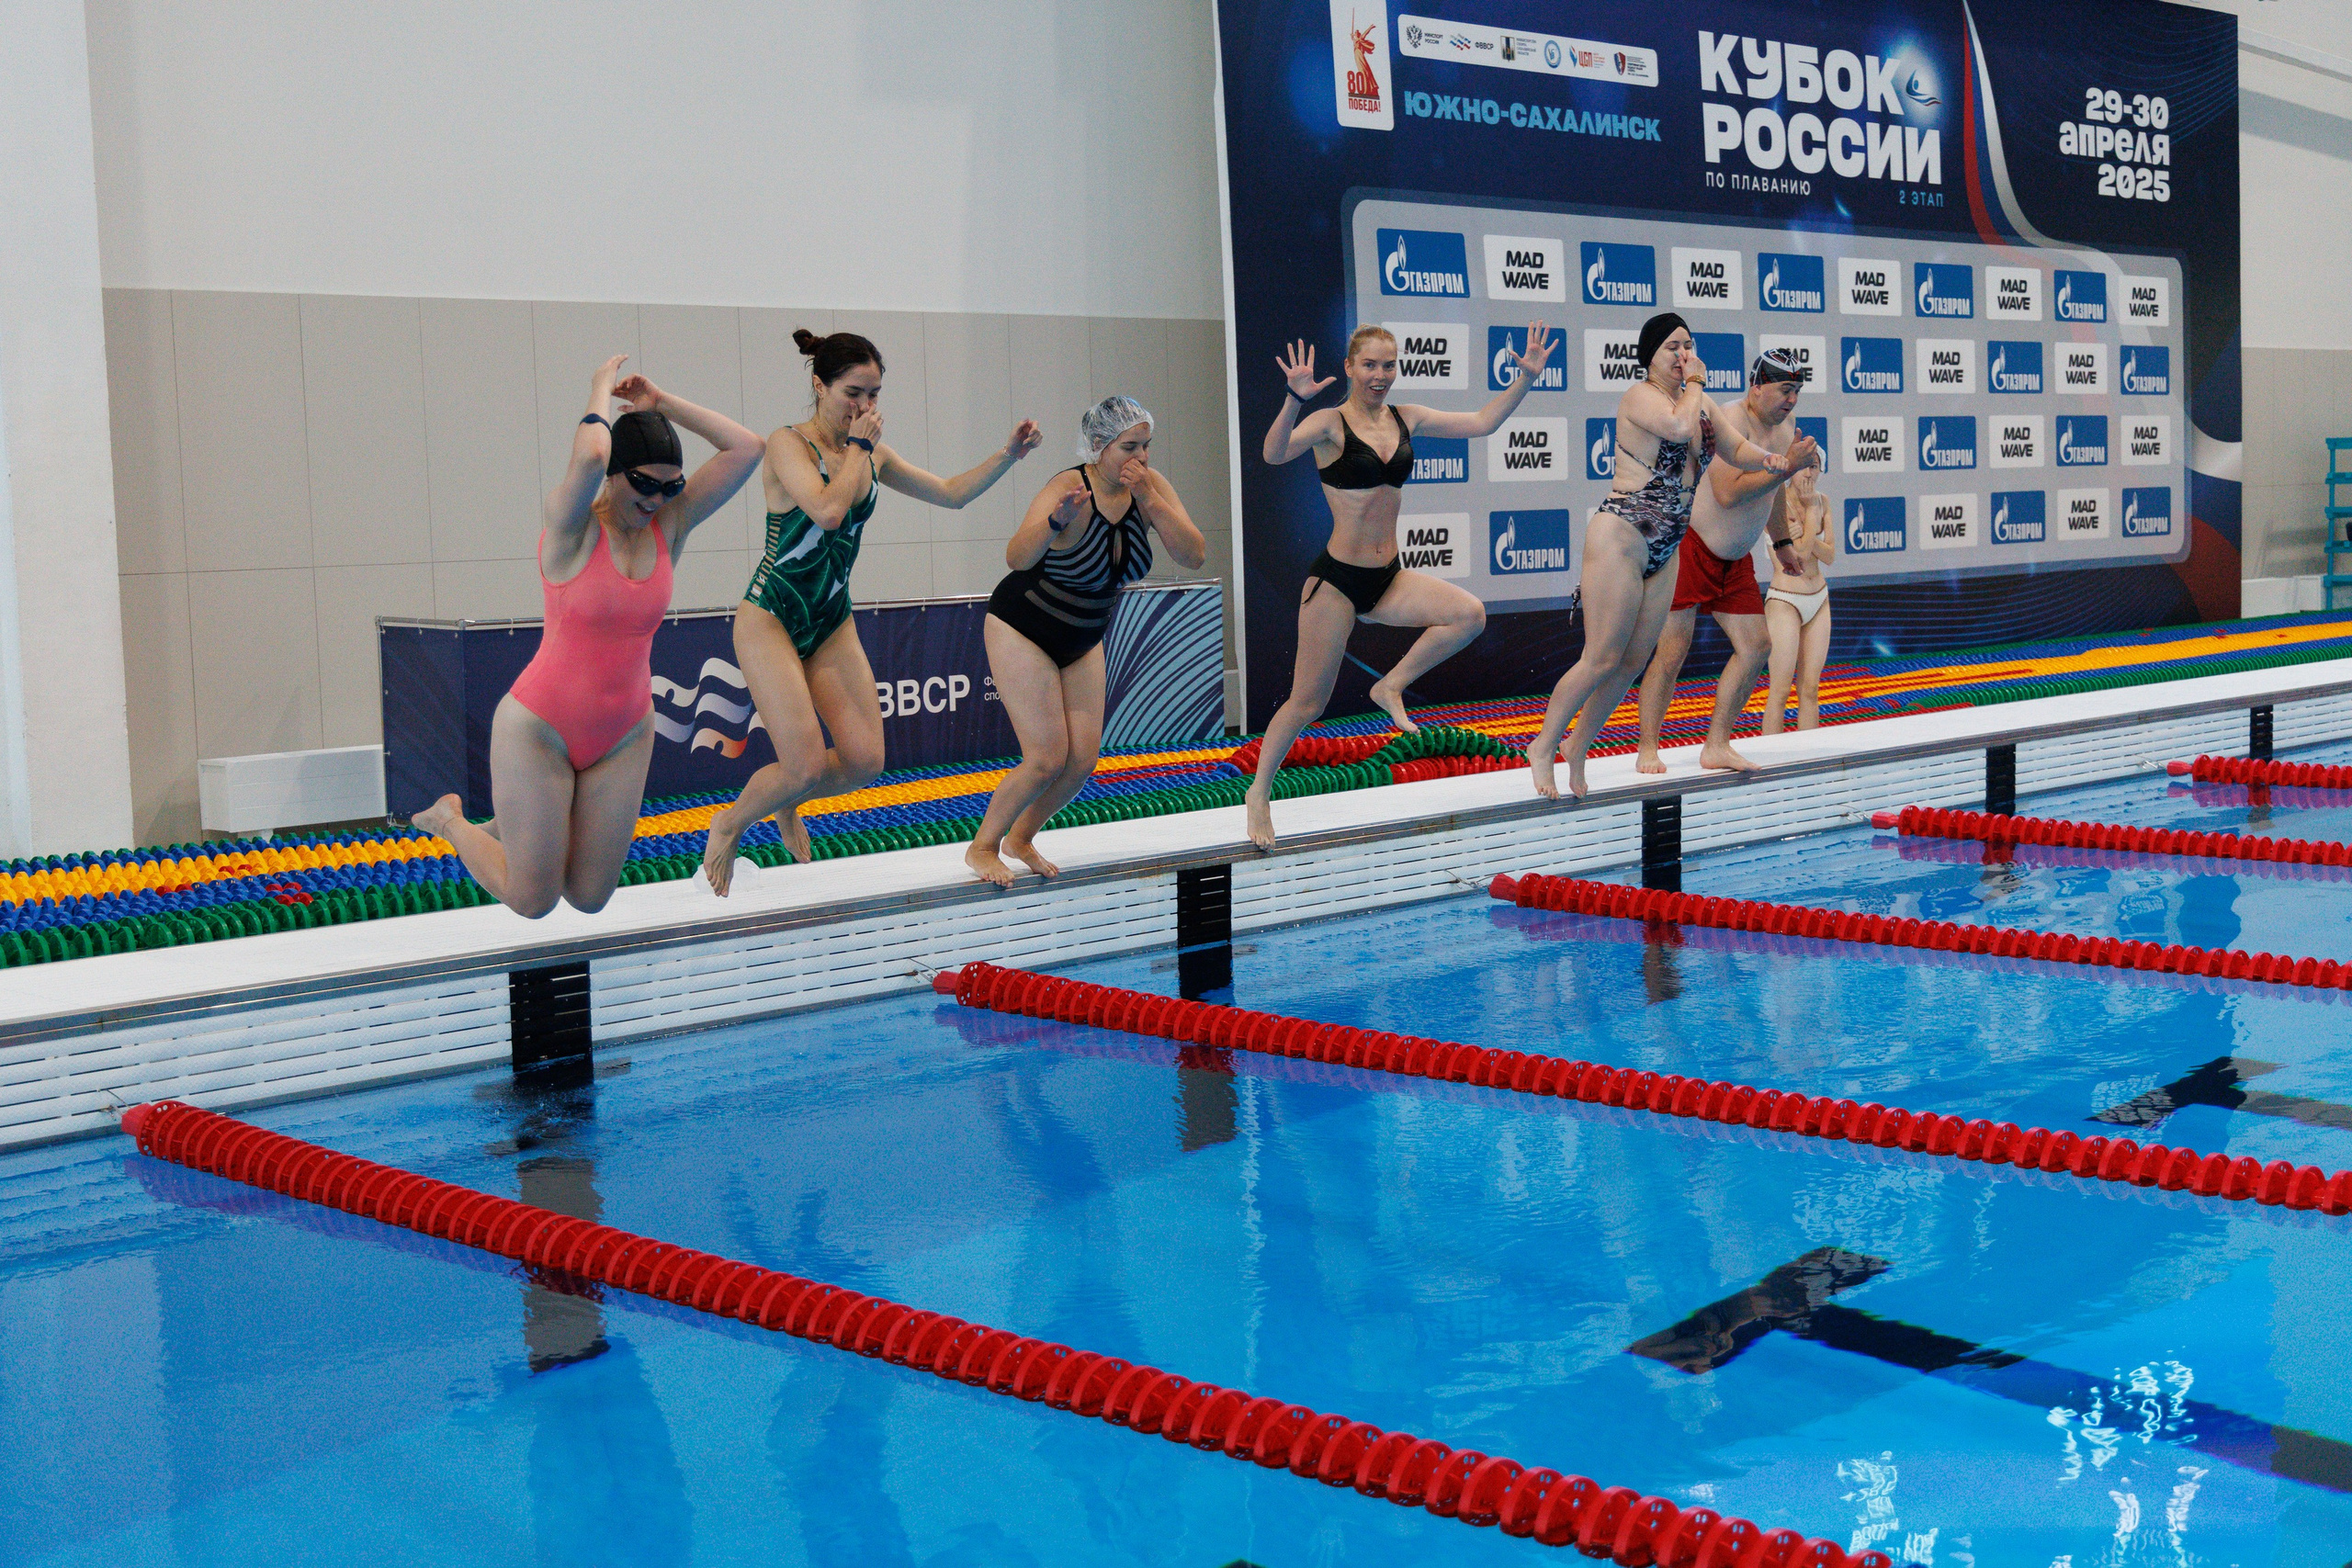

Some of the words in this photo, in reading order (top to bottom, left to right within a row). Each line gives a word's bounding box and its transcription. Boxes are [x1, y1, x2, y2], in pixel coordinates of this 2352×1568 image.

[1475, 41, 1494, 51] ФВВСР
[1578, 51, 1593, 68] ЦСП
[1699, 30, 1905, 115] КУБОК
[1347, 71, 1364, 94] 80
[1348, 97, 1381, 113] ПОБЕДА!
[2086, 87, 2169, 130] 29-30
[1404, 90, 1661, 141] ЮЖНО-САХАЛИНСК
[1702, 102, 1941, 185] РОССИИ
[1706, 172, 1724, 188] ПО
[1731, 174, 1811, 196] ПЛАВАНИЮ
[2098, 163, 2170, 202] 2025
[1899, 189, 1905, 205] 2
[1912, 191, 1944, 208] ЭТАП
[1506, 251, 1544, 268] MAD
[1690, 262, 1724, 278] MAD
[1410, 272, 1464, 294] ГАЗПРОМ
[1502, 271, 1549, 289] WAVE
[1855, 271, 1885, 287] MAD
[2000, 279, 2027, 293] MAD
[1607, 281, 1652, 303] ГАЗПРОМ
[1687, 281, 1728, 299] WAVE
[1851, 289, 1889, 305] WAVE
[2132, 288, 2156, 301] MAD
[1781, 289, 1821, 310] ГАЗПРОМ
[1934, 298, 1970, 315] ГАЗПРОМ
[1997, 296, 2030, 310] WAVE
[2071, 303, 2104, 320] ГАЗПРОМ
[2130, 303, 2158, 317] WAVE
[1404, 337, 1447, 355] MAD
[1604, 344, 1639, 359] MAD
[1932, 352, 1960, 365] MAD
[2069, 355, 2094, 367] MAD
[1399, 359, 1451, 377] WAVE
[1600, 364, 1643, 379] WAVE
[1929, 369, 1963, 383] WAVE
[1862, 372, 1899, 389] ГАЗПРОМ
[2006, 374, 2040, 390] ГАЗПРОМ
[2066, 371, 2097, 384] WAVE
[2136, 377, 2166, 392] ГАЗПРОМ
[1509, 432, 1547, 448] MAD
[1859, 429, 1888, 443] MAD
[2004, 427, 2030, 440] MAD
[2134, 426, 2158, 439] MAD
[1855, 447, 1892, 462] WAVE
[1938, 449, 1973, 467] ГАЗПРОМ
[2000, 444, 2033, 457] WAVE
[2073, 446, 2105, 463] ГАЗПРОМ
[2132, 443, 2160, 456] WAVE
[1504, 452, 1552, 469] WAVE
[1935, 506, 1962, 520] MAD
[2071, 500, 2096, 513] MAD
[1931, 523, 1966, 538] WAVE
[2008, 522, 2042, 540] ГАЗПРОМ
[2068, 515, 2098, 530] WAVE
[2137, 517, 2167, 534] ГАЗПРОМ
[1407, 528, 1448, 547] MAD
[1865, 531, 1902, 549] ГАЗПРОМ
[1402, 549, 1453, 569] WAVE
[1516, 547, 1565, 570] ГАЗПРОМ
[876, 674, 970, 718] ВВСР
